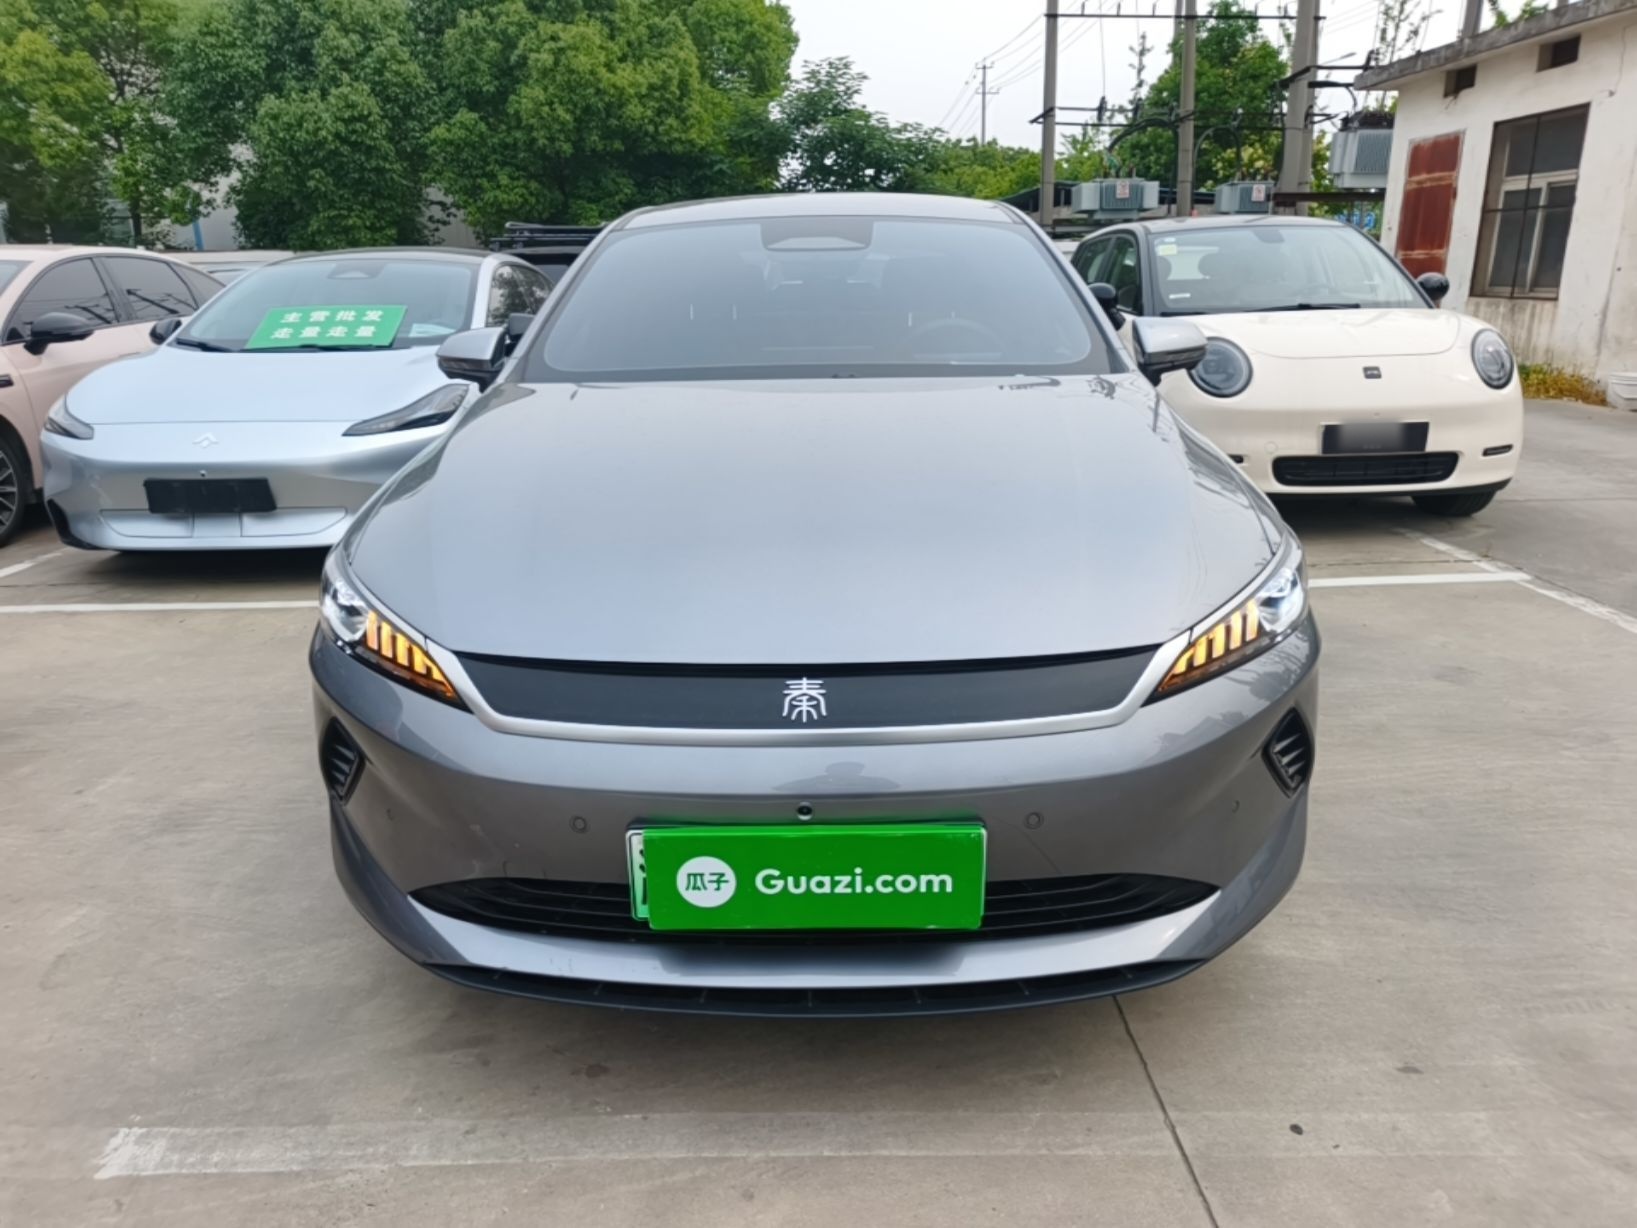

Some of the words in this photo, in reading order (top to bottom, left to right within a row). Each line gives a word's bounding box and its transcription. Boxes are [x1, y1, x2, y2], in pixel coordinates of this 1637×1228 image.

[280, 310, 384, 322] 主营批发
[782, 677, 827, 723] 秦
[685, 872, 730, 891] 瓜子
[754, 867, 953, 895] Guazi.com
